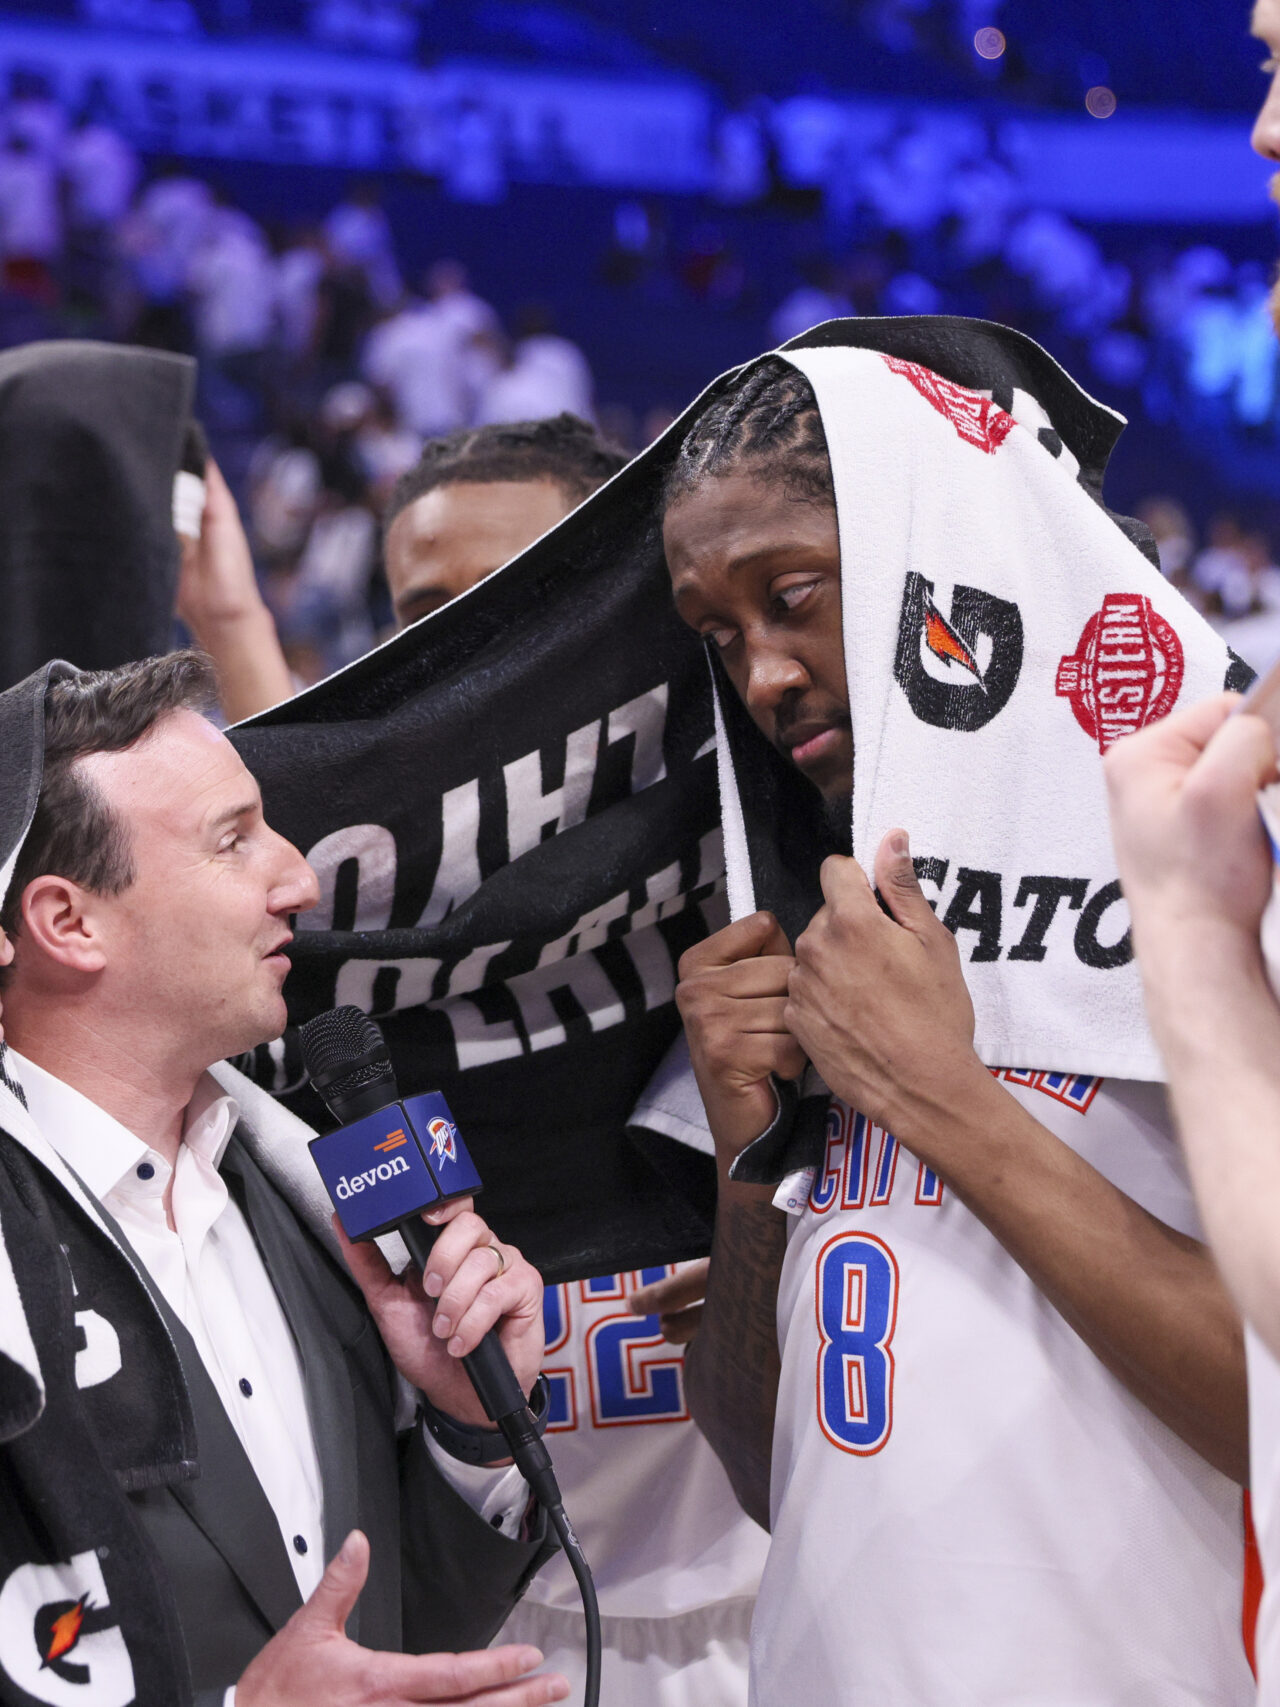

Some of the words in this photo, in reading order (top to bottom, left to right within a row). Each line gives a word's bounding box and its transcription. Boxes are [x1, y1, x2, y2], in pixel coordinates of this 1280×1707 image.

[1057, 659, 1080, 692] NBA
[335, 1155, 411, 1200] devon
[815, 1230, 900, 1457] 8
